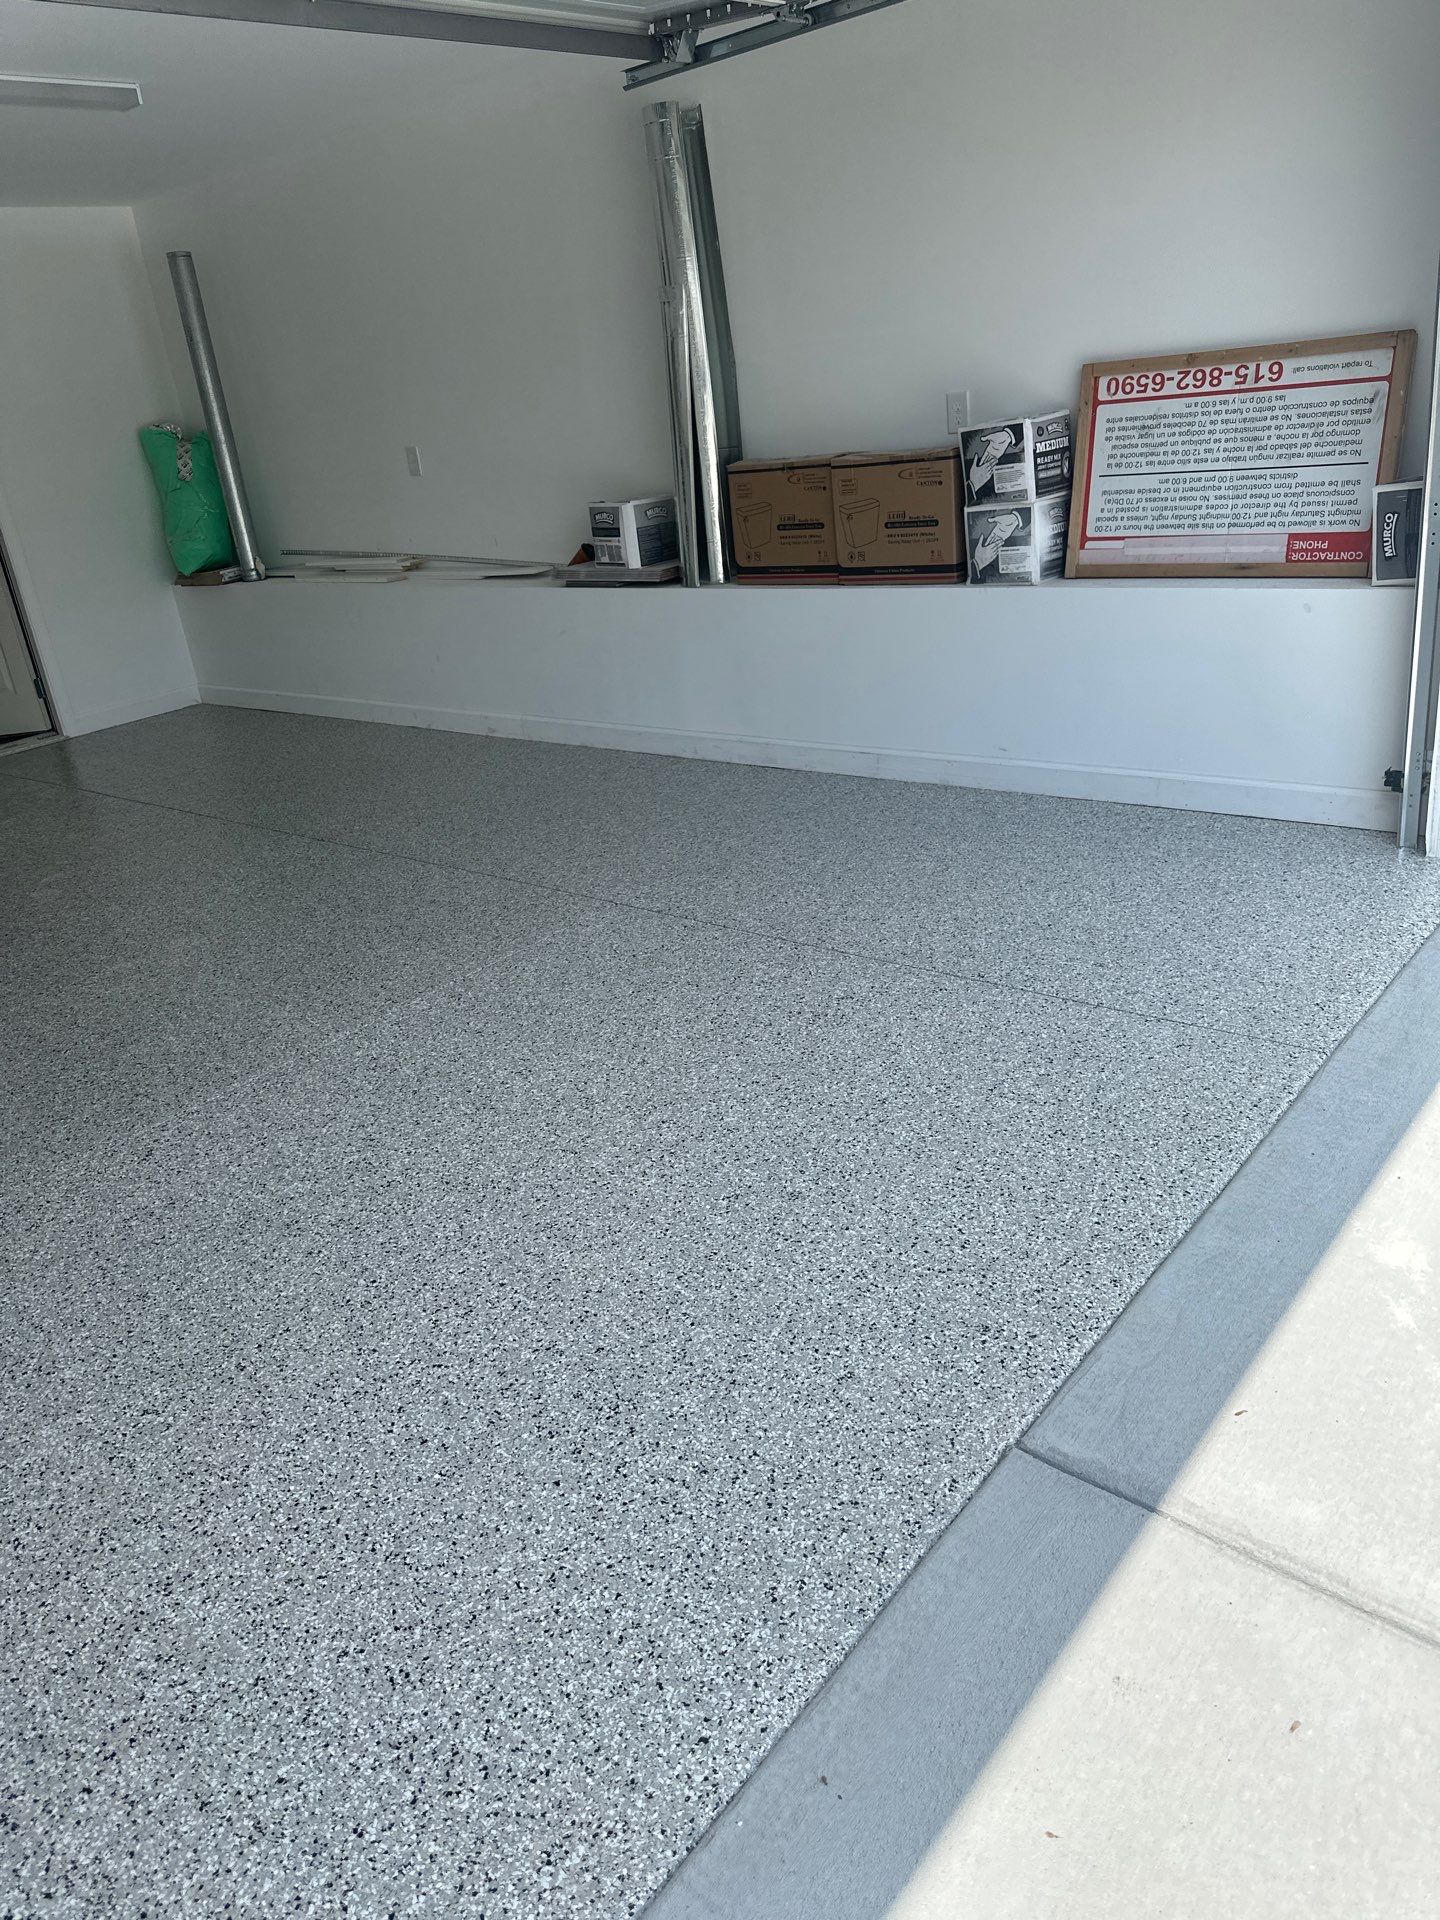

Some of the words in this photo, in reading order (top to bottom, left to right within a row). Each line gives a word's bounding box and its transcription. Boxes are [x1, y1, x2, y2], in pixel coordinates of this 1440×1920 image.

[1341, 360, 1362, 369] report
[1106, 361, 1283, 396] 615-862-6590
[1342, 396, 1373, 406] equipos
[1252, 405, 1276, 413] dentro
[1278, 401, 1327, 411] construcción
[1124, 413, 1169, 422] residenciales
[1238, 415, 1267, 424] emitirán
[1341, 418, 1371, 426] emitido
[1117, 422, 1161, 432] provenientes
[1162, 420, 1196, 429] decibeles
[1285, 422, 1315, 430] director
[1177, 429, 1205, 437] códigos
[1218, 425, 1272, 434] administración
[1325, 429, 1360, 437] domingo
[1035, 436, 1069, 453] MEDIUM
[1140, 439, 1168, 449] permiso
[1180, 437, 1211, 446] publique
[1269, 442, 1297, 450] sábado
[1314, 438, 1362, 448] medianoche
[1110, 442, 1138, 451] especial
[1119, 451, 1160, 459] medianoche
[1248, 452, 1273, 461] ningún
[1306, 448, 1335, 458] permite
[1221, 454, 1246, 463] trabajo
[1269, 472, 1298, 480] districts
[1181, 484, 1221, 493] equipment
[1224, 483, 1271, 491] construction
[1294, 481, 1325, 489] emitted
[1283, 490, 1304, 498] place
[1305, 488, 1354, 497] conspicuous
[1104, 497, 1124, 505] Db(a)
[1288, 500, 1298, 508] by
[1330, 497, 1357, 507] permit
[646, 506, 668, 516] MURCO
[1115, 505, 1139, 514] posted
[1150, 504, 1202, 512] administration
[1327, 507, 1361, 516] midnight
[594, 512, 614, 521] MURCO
[1170, 513, 1196, 521] Sunday
[1198, 512, 1229, 520] midnight
[1270, 509, 1288, 518] night
[1290, 509, 1325, 517] Saturday
[1095, 515, 1118, 523] special
[1227, 520, 1264, 529] performed
[1383, 512, 1394, 557] MURCO
[1290, 540, 1327, 548] PHONE:
[1288, 551, 1362, 560] CONTRACTOR:
